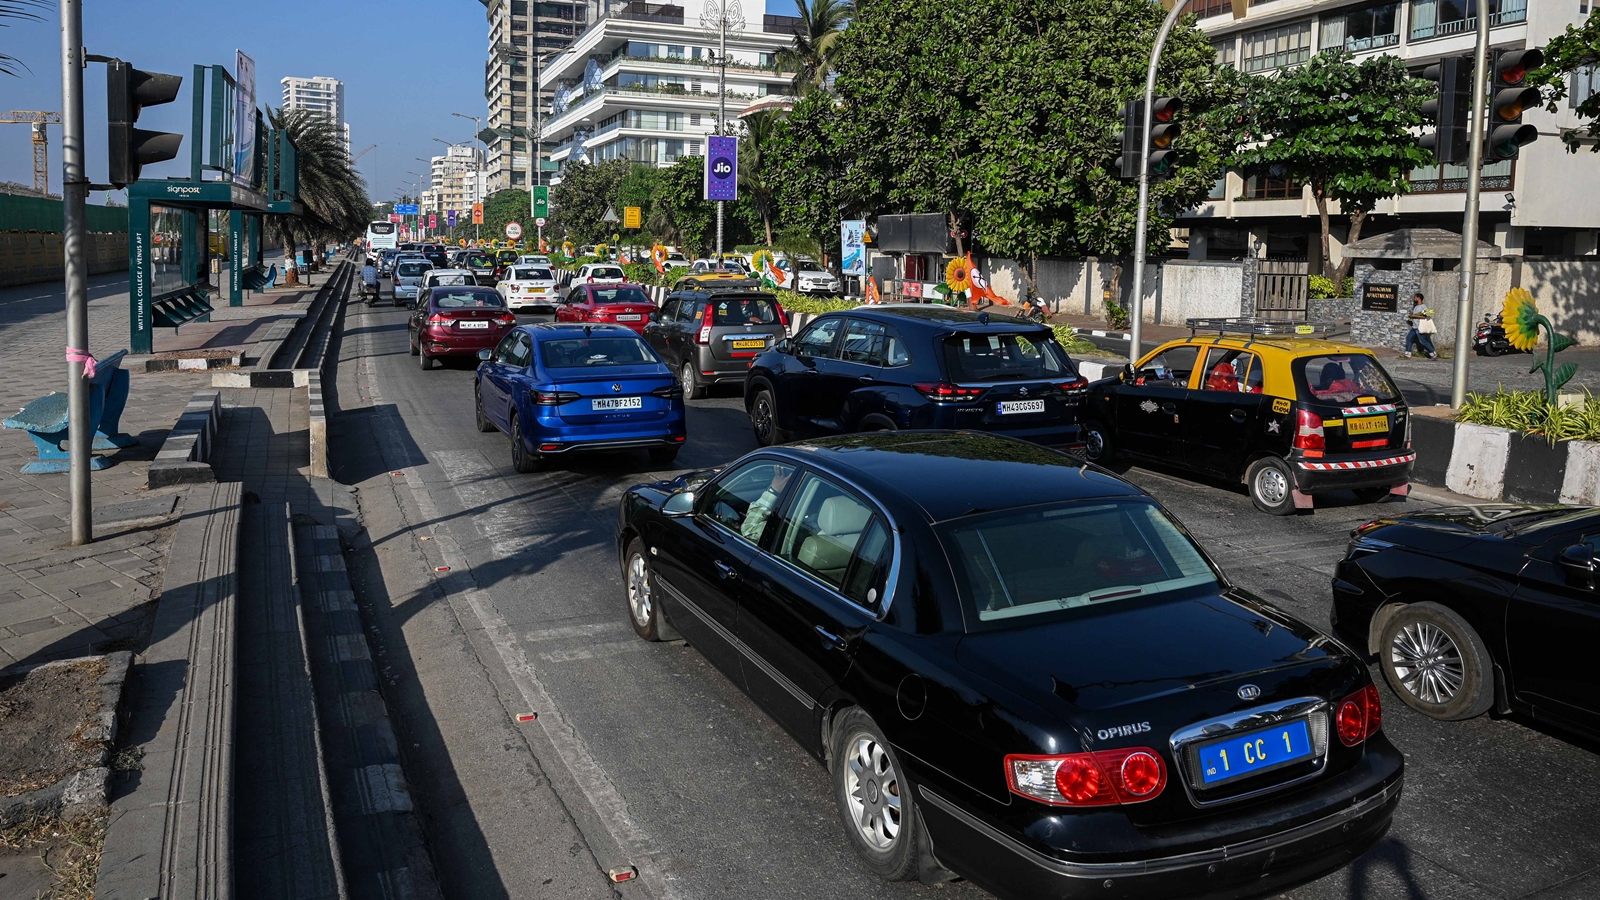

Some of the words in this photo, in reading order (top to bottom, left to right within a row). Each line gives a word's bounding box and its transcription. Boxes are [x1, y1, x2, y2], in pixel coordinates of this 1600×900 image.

[714, 162, 731, 173] Jio
[167, 185, 200, 193] signpost
[597, 398, 641, 408] MH47BF2152
[1002, 401, 1043, 412] MH43CG5697
[1239, 687, 1258, 698] KIA
[1097, 721, 1151, 740] OPIRUS
[1220, 749, 1230, 771] 1
[1243, 739, 1266, 764] CC
[1282, 731, 1292, 753] 1
